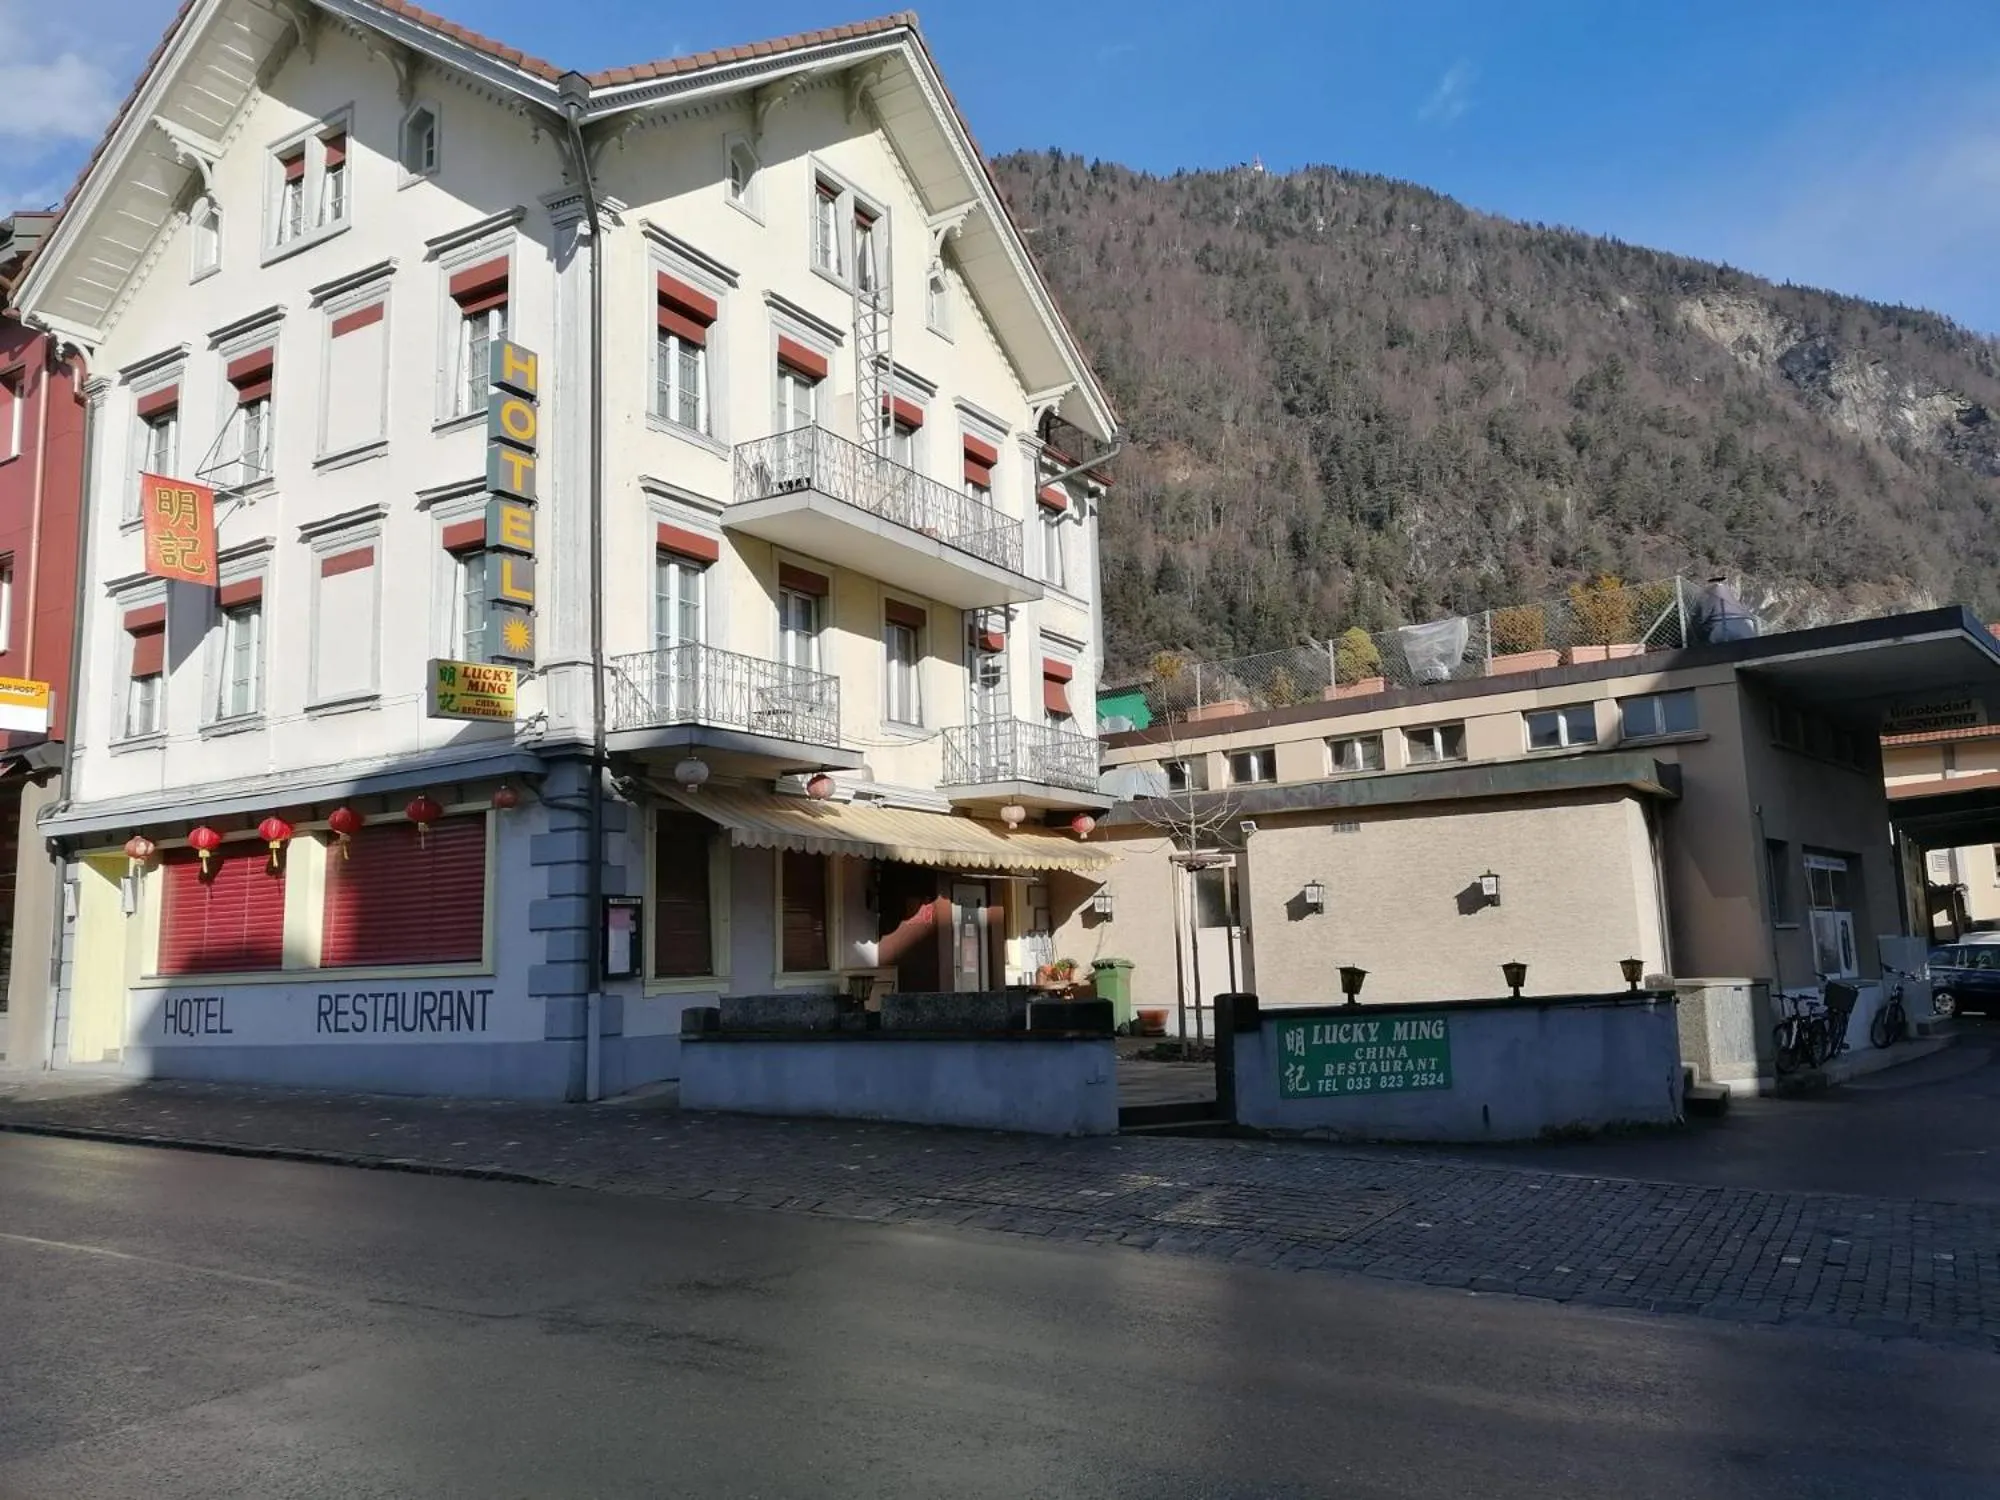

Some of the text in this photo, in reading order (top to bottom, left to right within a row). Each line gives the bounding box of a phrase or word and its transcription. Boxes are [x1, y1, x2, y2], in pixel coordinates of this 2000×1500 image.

[501, 343, 535, 600] HOTEL
[152, 487, 208, 576] 明記
[461, 666, 514, 682] LUCKY
[467, 680, 507, 694] MING
[462, 706, 514, 718] RESTAURANT
[475, 699, 500, 708] CHINA
[164, 989, 494, 1037] HOTEL RESTAURANT
[1312, 1019, 1445, 1045] LUCKY MING
[1354, 1046, 1408, 1060] CHINA
[1324, 1057, 1438, 1077] RESTAURANT
[1317, 1072, 1444, 1093] TEL 033 823 2524
